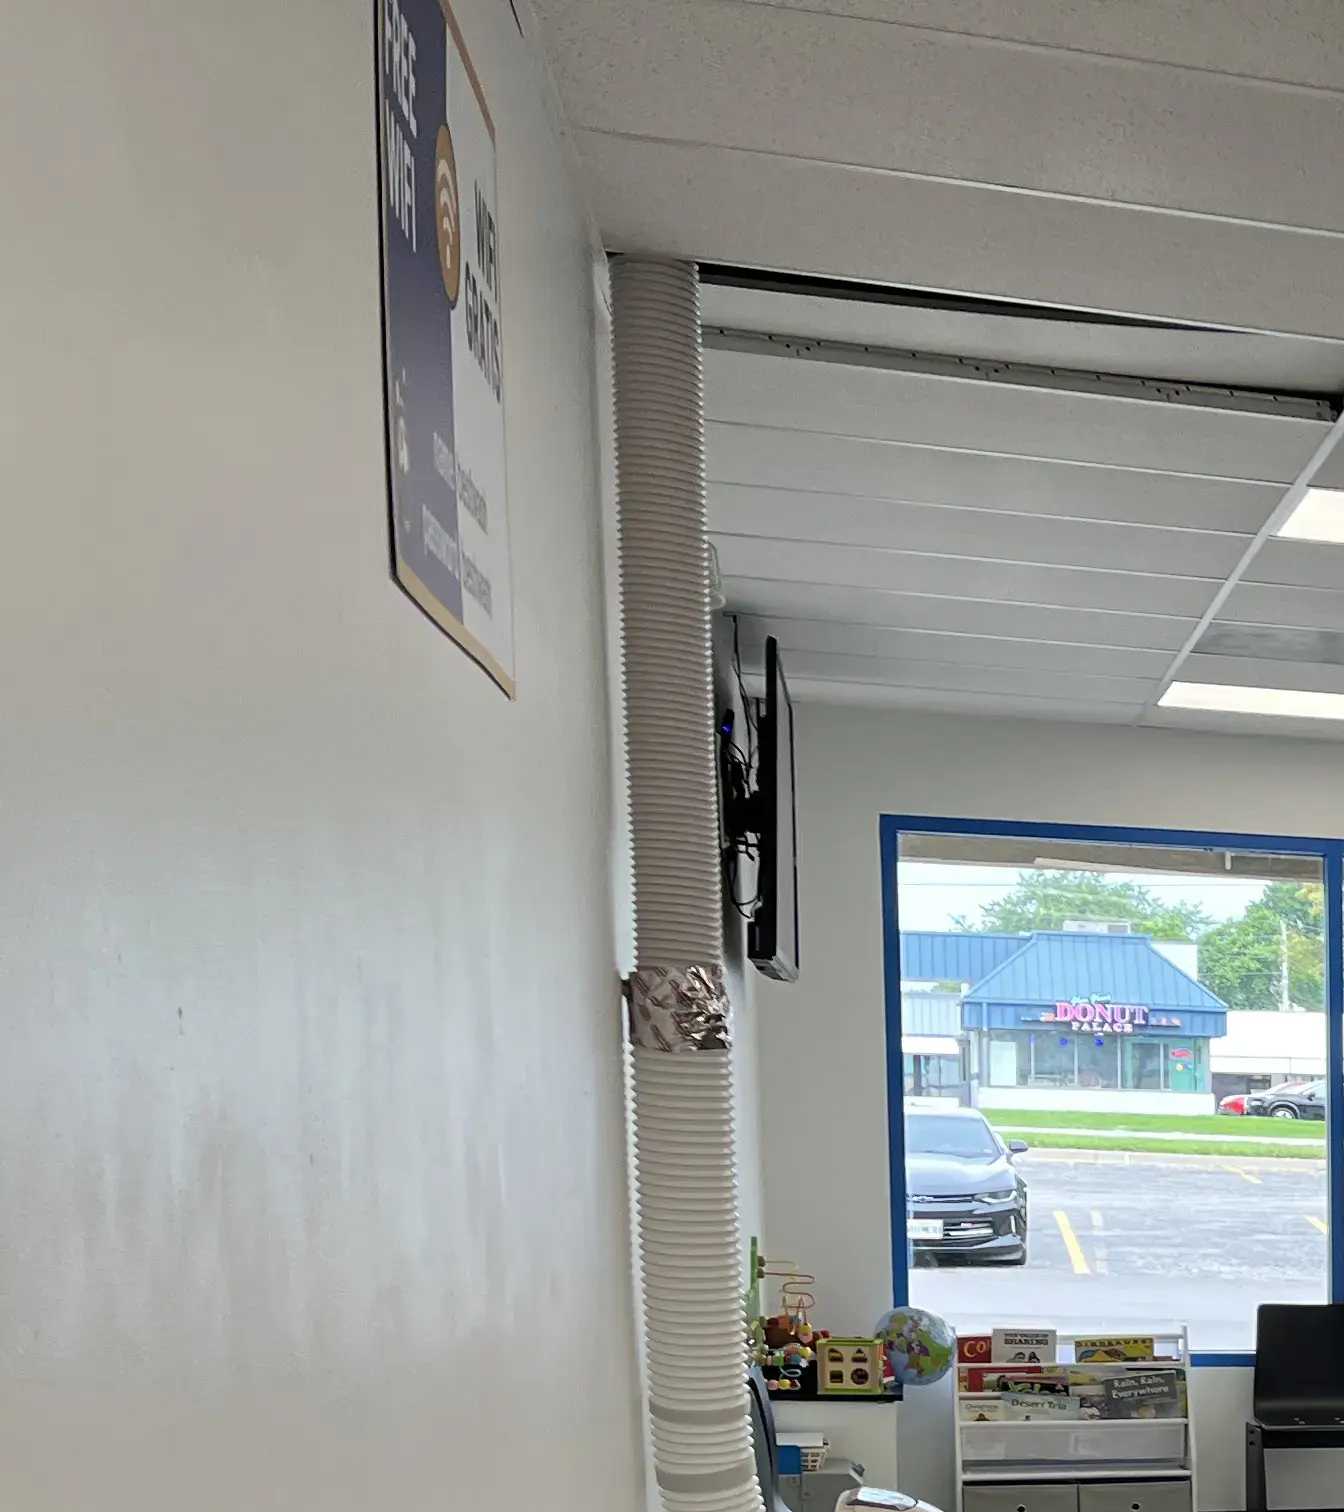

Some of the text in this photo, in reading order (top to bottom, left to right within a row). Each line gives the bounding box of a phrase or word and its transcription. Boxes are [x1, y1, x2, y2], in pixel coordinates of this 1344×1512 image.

[384, 0, 417, 139] FREE
[384, 99, 417, 253] WIFI
[464, 260, 501, 404] GRATIS
[1055, 1002, 1149, 1025] DONUT
[1071, 1022, 1134, 1033] PALACE
